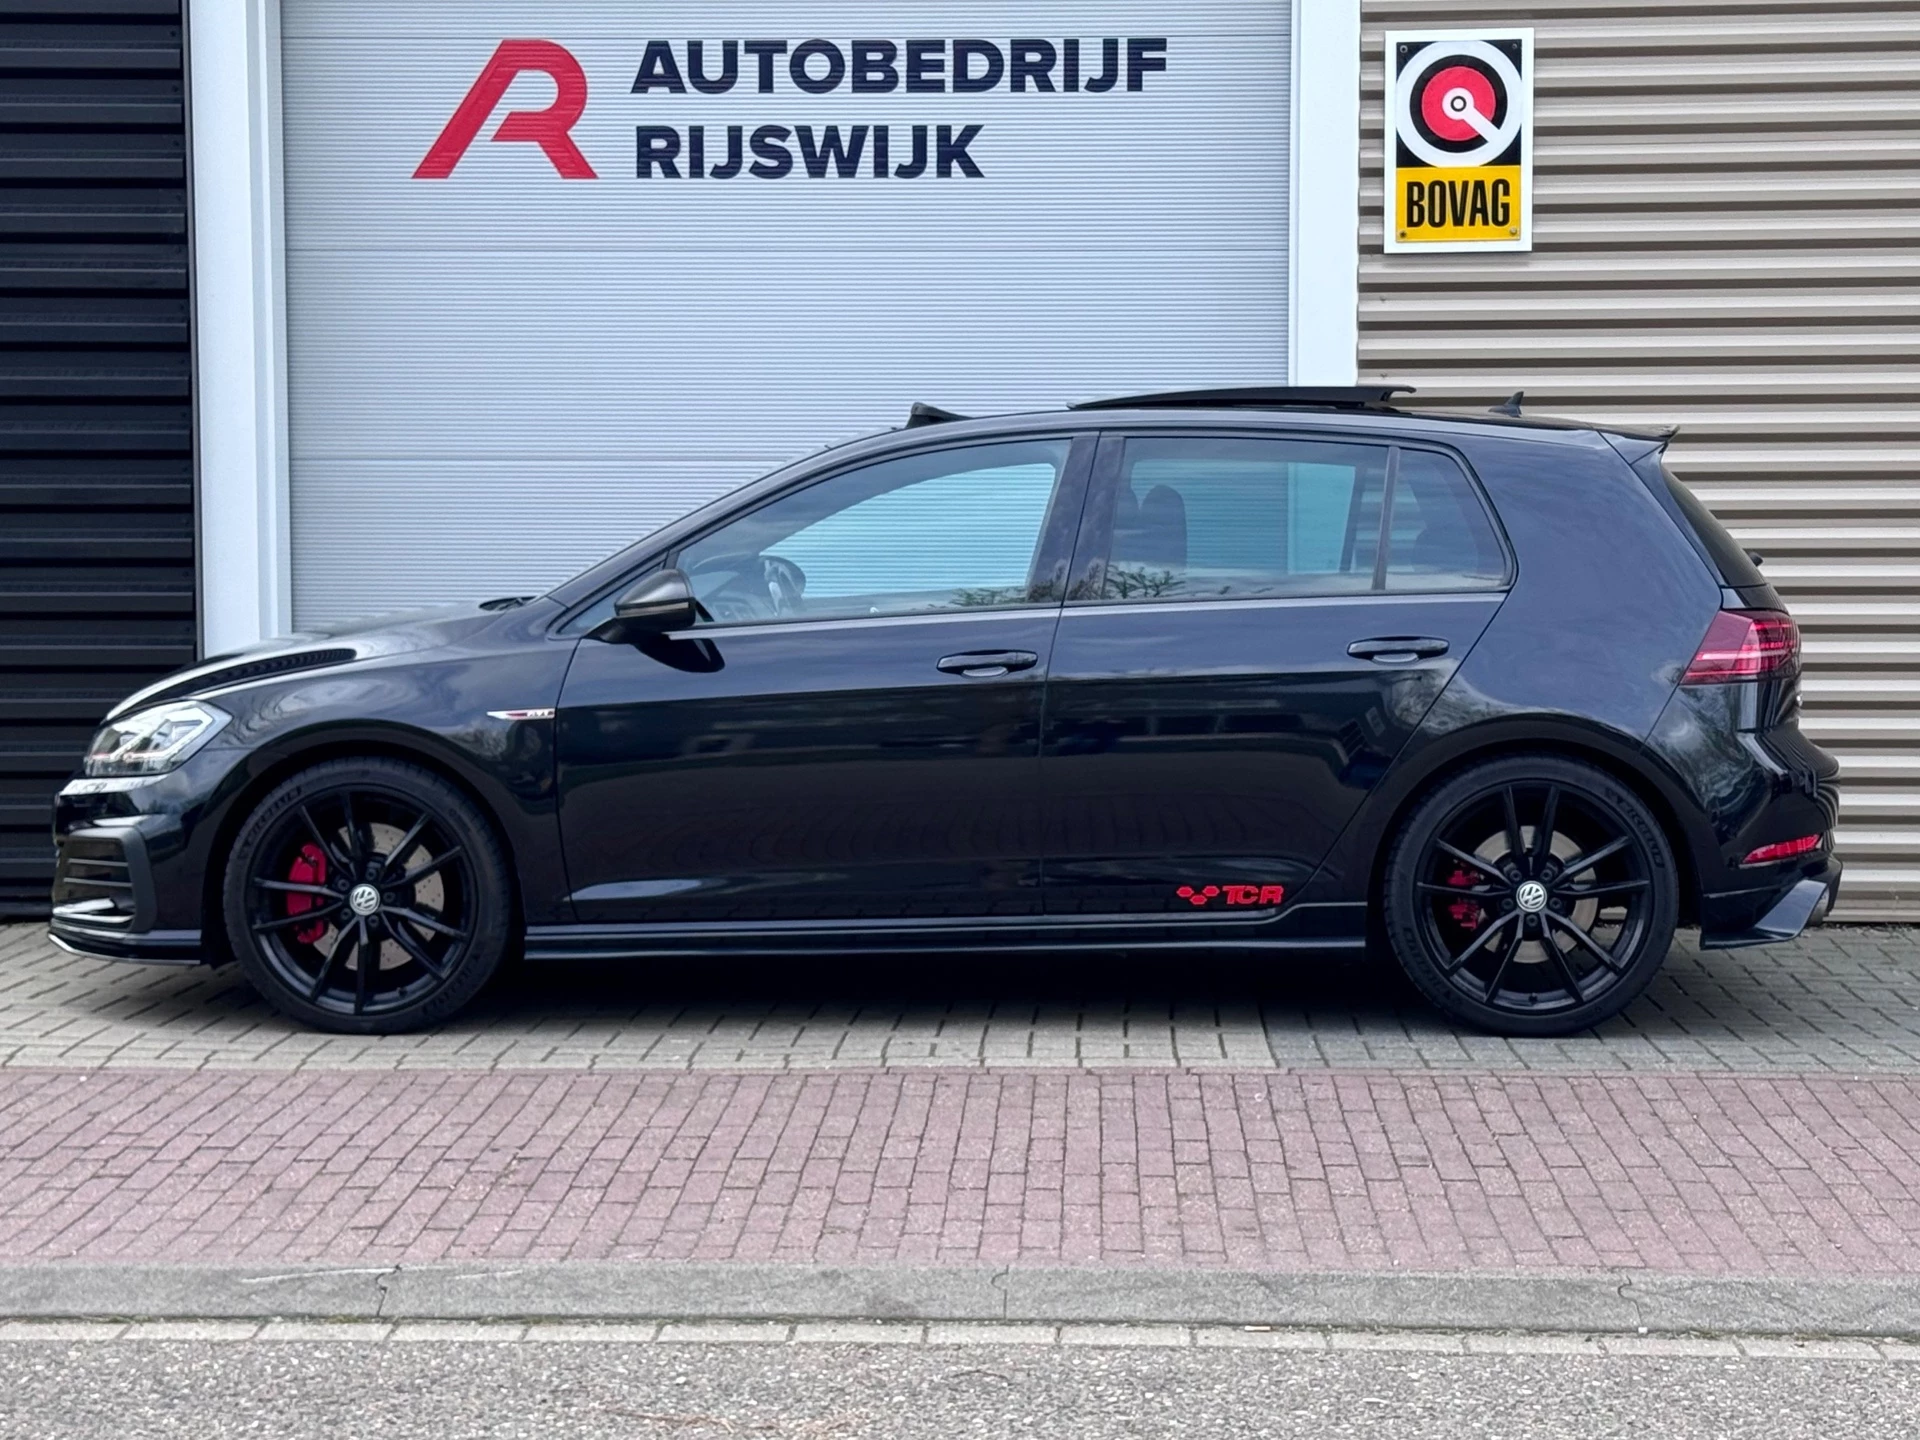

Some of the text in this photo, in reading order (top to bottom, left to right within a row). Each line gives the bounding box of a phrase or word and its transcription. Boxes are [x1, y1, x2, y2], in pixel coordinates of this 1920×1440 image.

[631, 38, 1167, 94] AUTOBEDRIJF
[637, 125, 984, 179] RIJSWIJK
[1407, 179, 1510, 228] BOVAG
[1222, 885, 1284, 905] TCR
